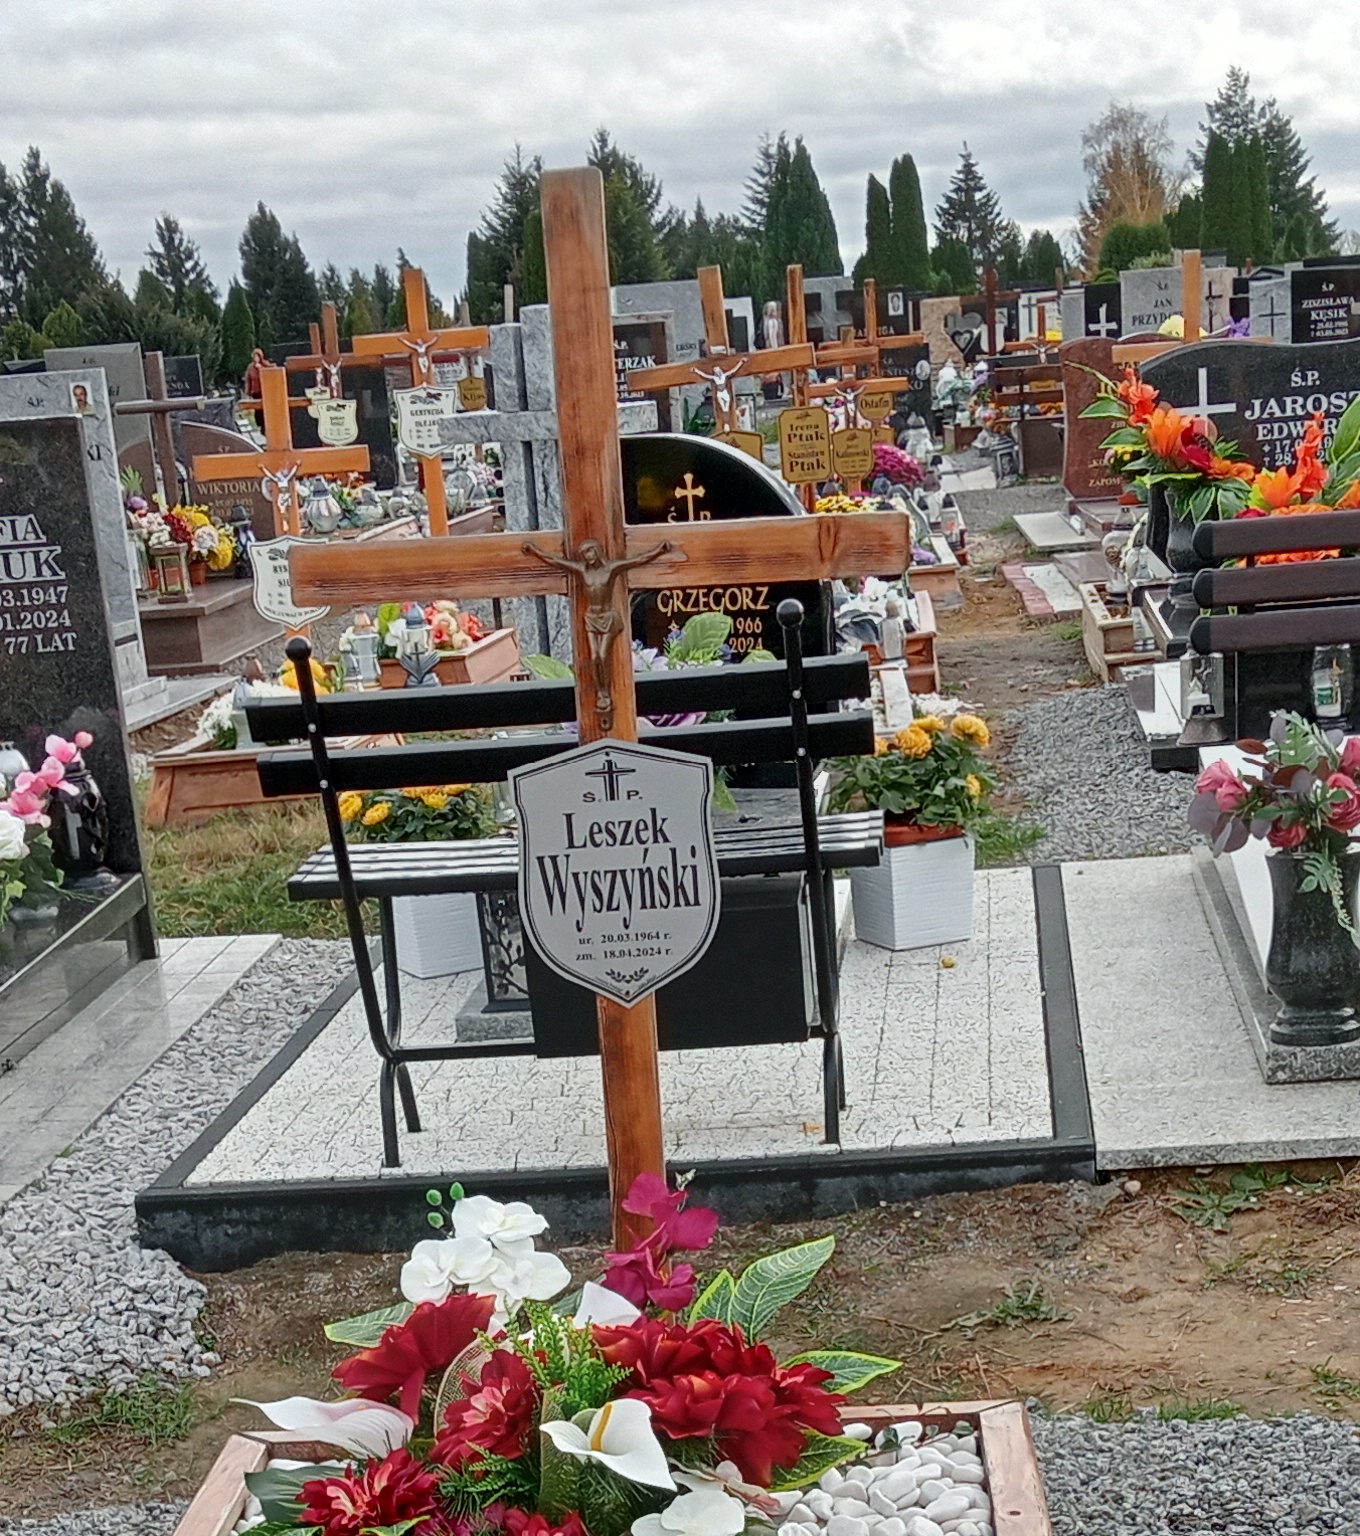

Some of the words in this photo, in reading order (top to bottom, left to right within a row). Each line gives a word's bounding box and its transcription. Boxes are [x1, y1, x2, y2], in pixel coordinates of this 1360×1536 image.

[615, 355, 658, 369] ERZAK
[1291, 367, 1320, 387] Ś.P.
[787, 431, 825, 443] Ptak
[1256, 418, 1340, 441] EDWR
[789, 458, 826, 473] Ptak
[196, 481, 260, 496] WIKTORIA
[656, 585, 771, 617] GRZEGORZ
[4, 636, 29, 655] 77
[34, 632, 78, 653] LAT
[561, 807, 671, 850] Leszek
[535, 845, 702, 933] Wyszyński
[600, 931, 661, 945] 20.03.1964
[603, 947, 662, 960] 18.04.2024
